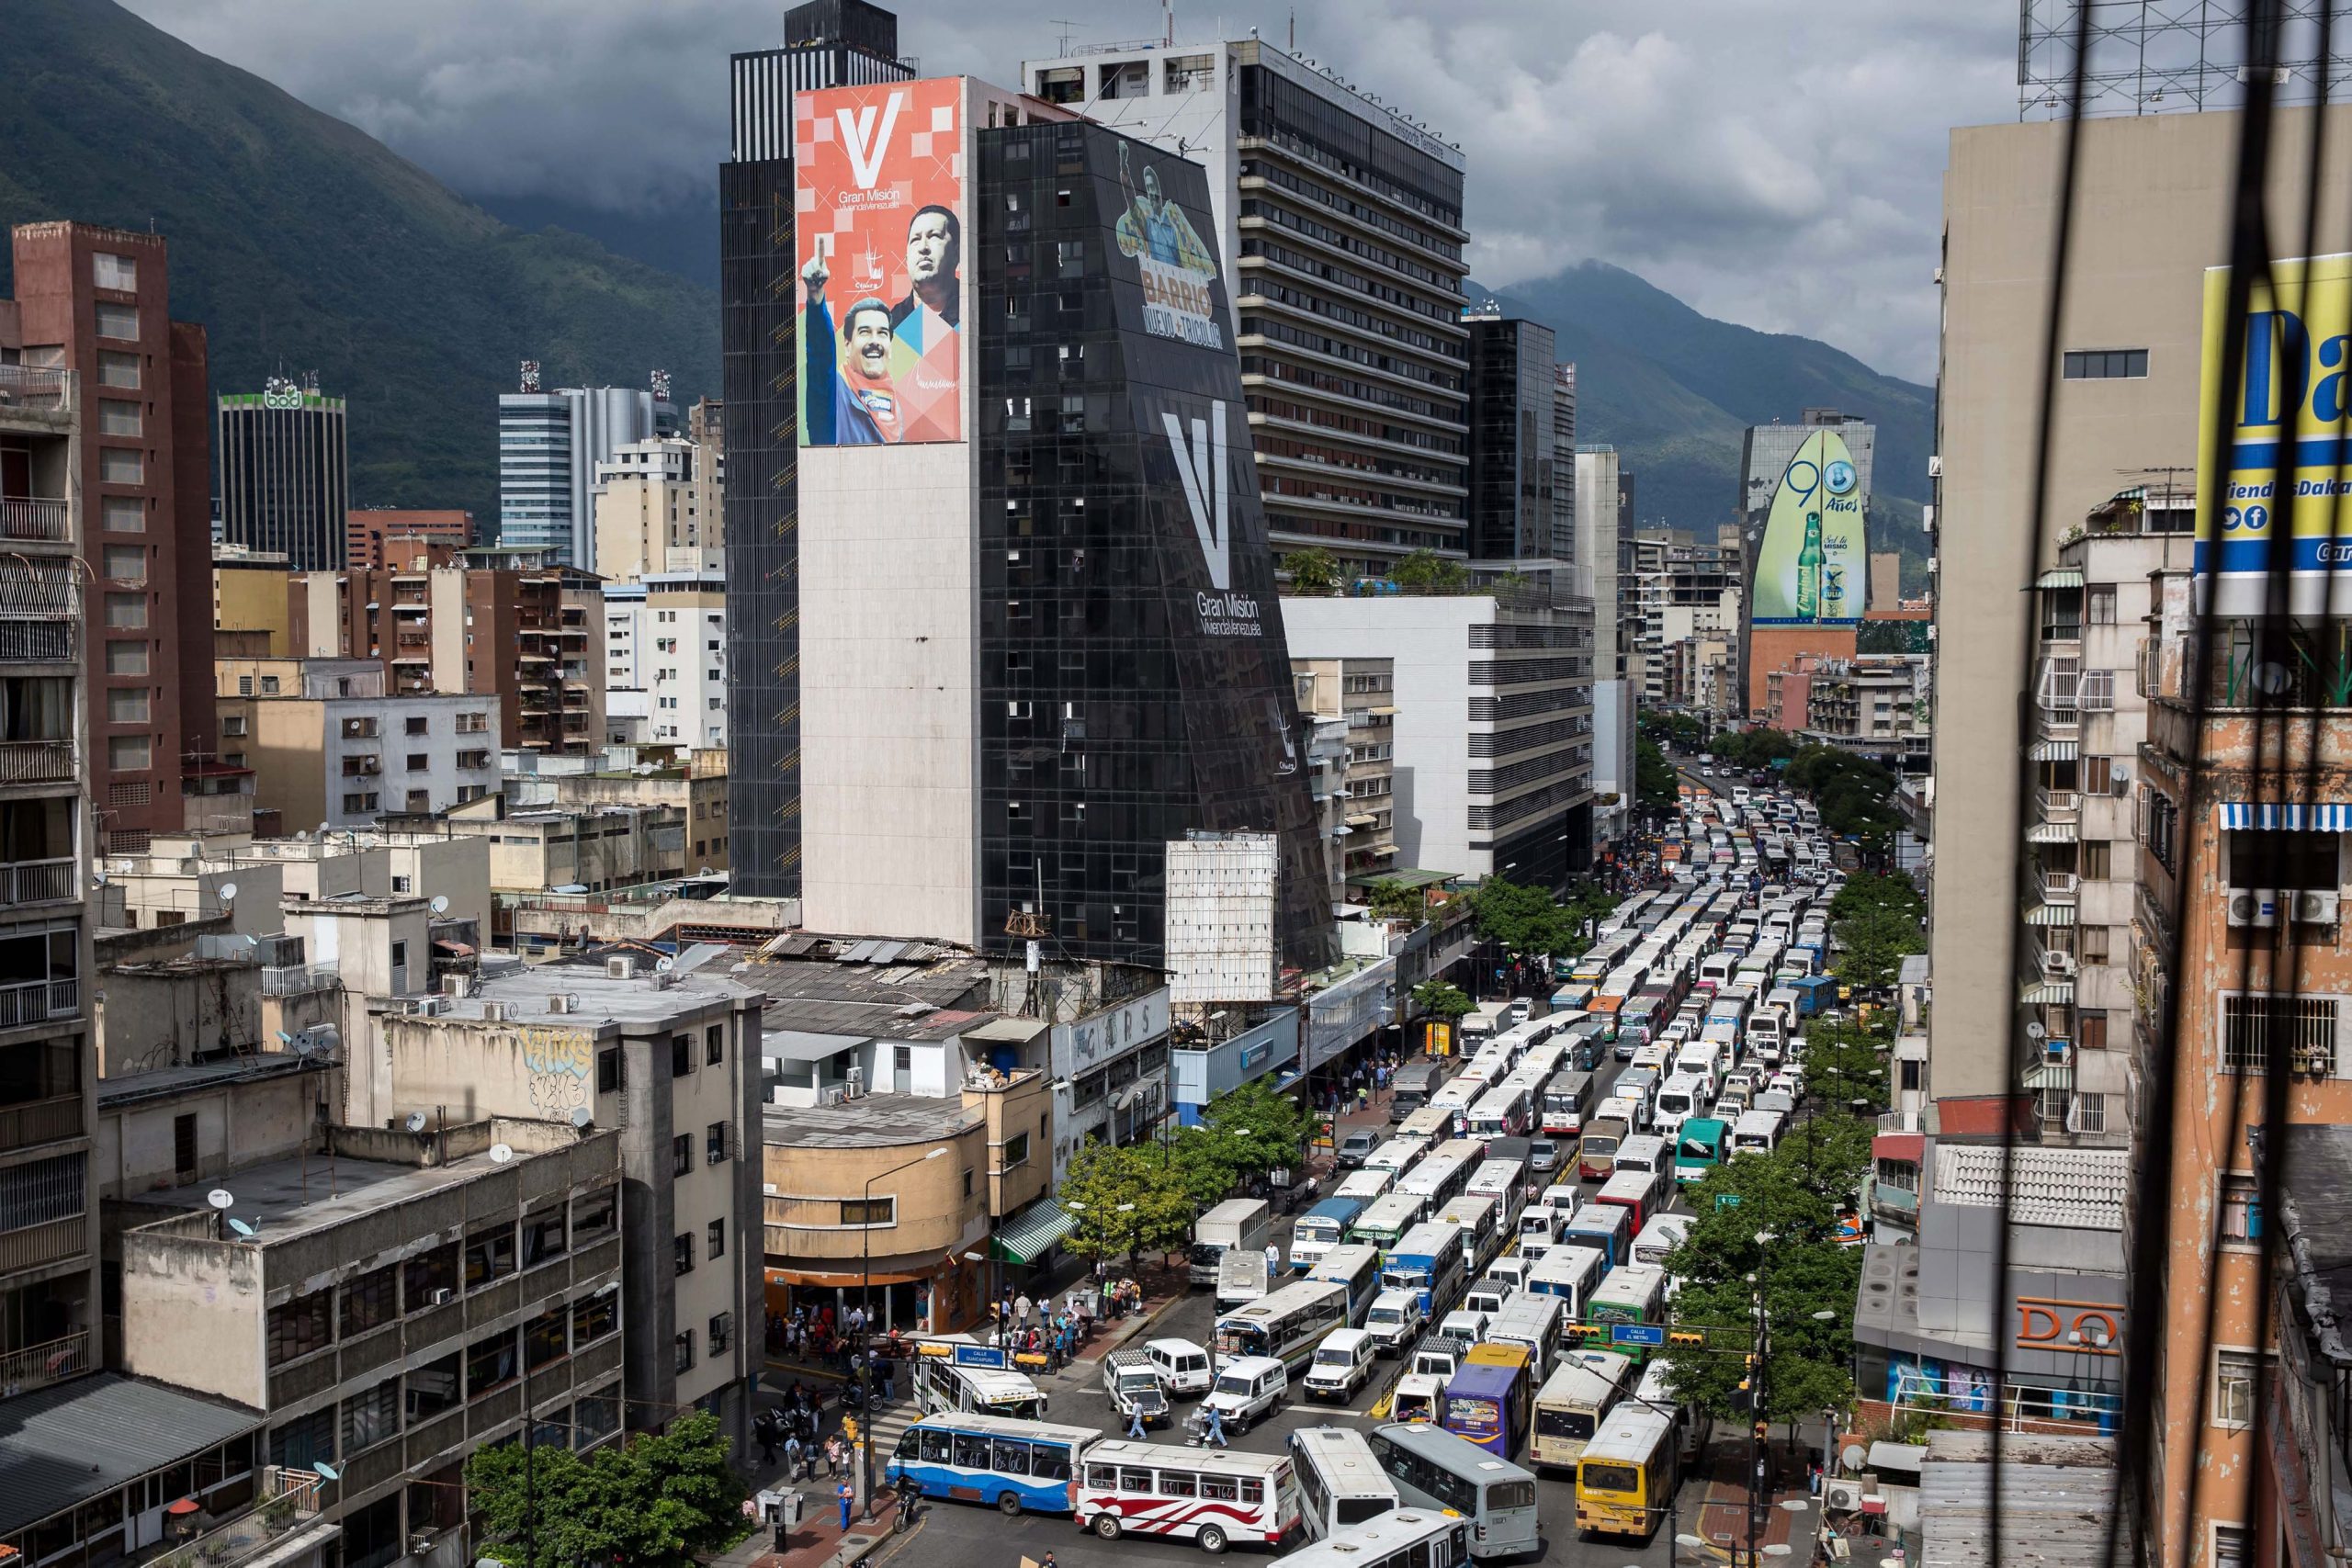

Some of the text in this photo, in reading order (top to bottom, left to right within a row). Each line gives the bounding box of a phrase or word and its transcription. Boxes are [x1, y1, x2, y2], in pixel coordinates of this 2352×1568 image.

[1389, 117, 1420, 146] Transporte
[1420, 134, 1443, 160] Terrestre
[839, 189, 900, 204] Gran Misión
[1141, 269, 1212, 318] BARRIO
[1143, 306, 1223, 349] NUEVO TRICOLOR
[1825, 497, 1858, 513] Años
[1796, 566, 1812, 613] Original
[1197, 591, 1260, 618] Gran Misión
[1200, 617, 1262, 637] ViviendaVenezuela
[922, 1446, 949, 1461] PASA
[968, 1451, 983, 1467] 60
[1009, 1451, 1024, 1471] 60
